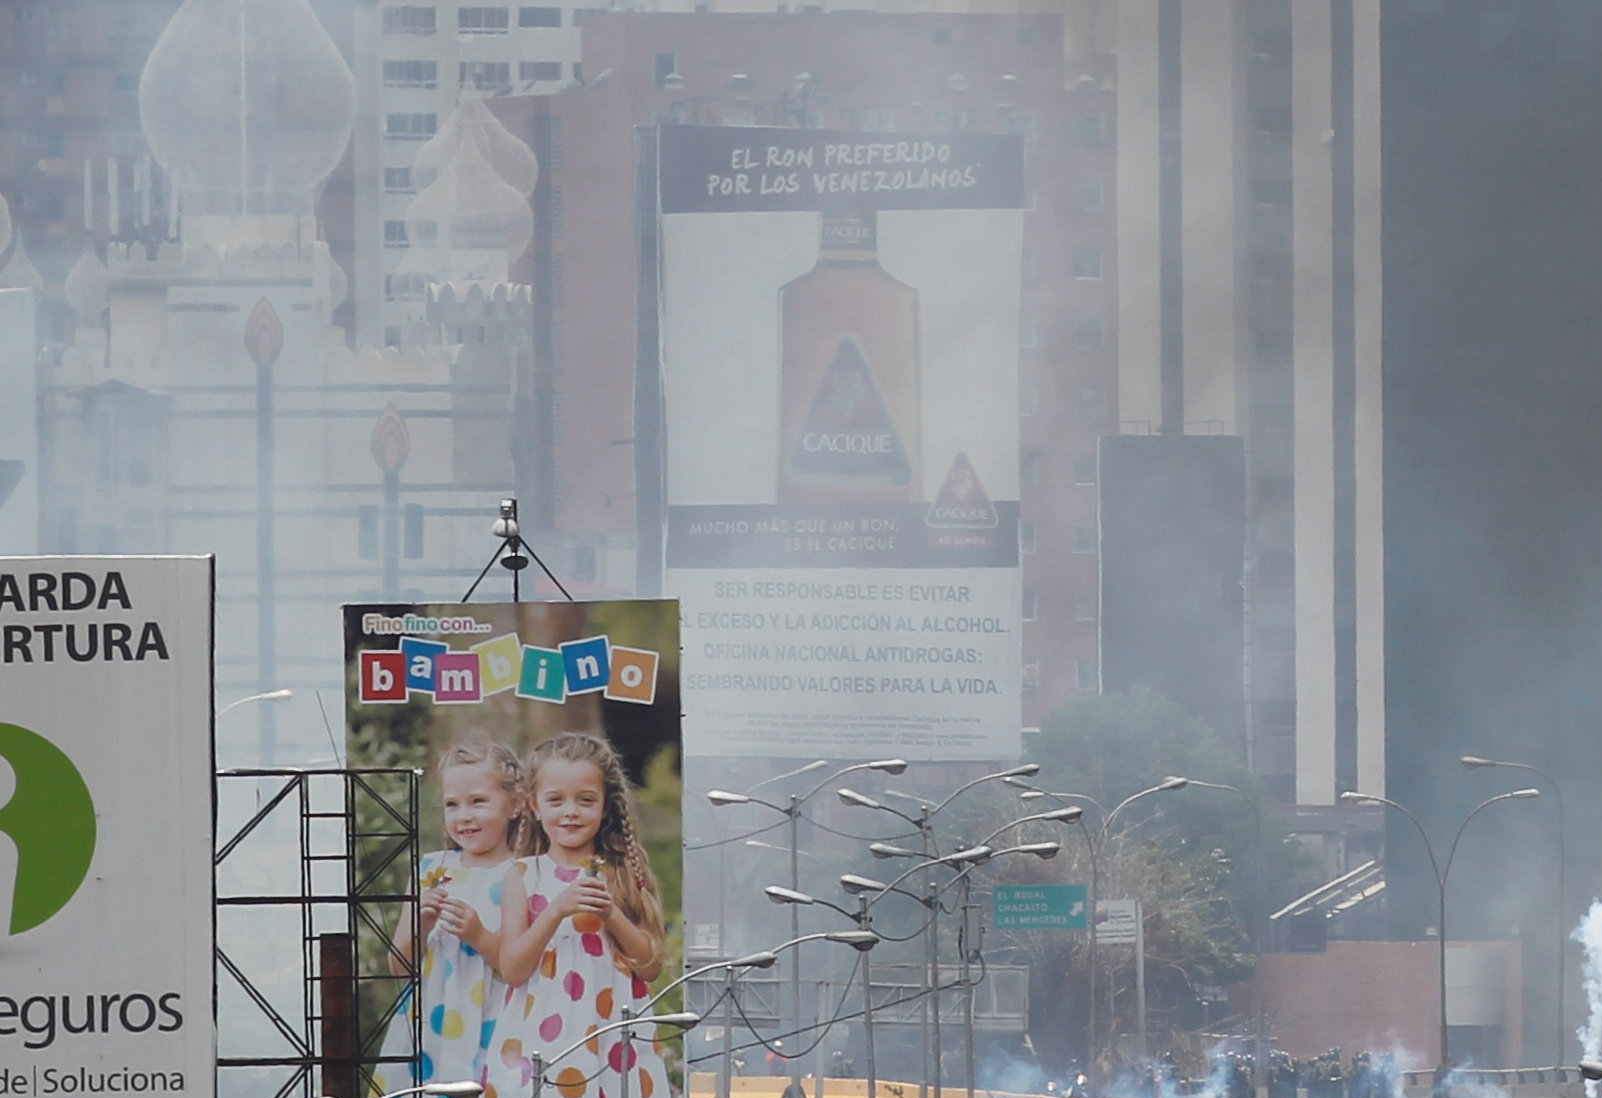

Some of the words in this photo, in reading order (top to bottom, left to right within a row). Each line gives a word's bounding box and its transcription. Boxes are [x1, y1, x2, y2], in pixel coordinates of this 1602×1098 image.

[731, 149, 760, 168] EL
[767, 146, 814, 168] RON
[825, 142, 950, 165] PREFERIDO
[707, 175, 752, 196] POR
[761, 173, 801, 194] LOS
[813, 166, 977, 193] VENEZOLANOS
[804, 433, 892, 453] CACIQUE
[689, 521, 749, 534] MUCHO
[795, 520, 825, 533] QUE
[833, 520, 853, 532] UN
[828, 536, 896, 550] CACIQUE
[0, 572, 132, 611] ARDA
[715, 582, 748, 599] SER
[753, 582, 877, 600] RESPONSABLE
[882, 584, 904, 599] ES
[909, 584, 969, 601] EVITAR
[698, 612, 766, 630] EXCESO
[769, 615, 780, 630] Y
[785, 614, 808, 631] LA
[811, 610, 891, 632] ADICCIÓN
[895, 615, 918, 632] AL
[921, 615, 1011, 634] ALCOHOL.
[3, 622, 170, 663] RTURA
[704, 643, 770, 662] OFICINA
[775, 644, 860, 662] NACIONAL
[864, 645, 983, 664] ANTIDROGAS:
[366, 641, 651, 697] bambino
[687, 674, 792, 691] SEMBRANDO
[798, 676, 876, 693] VALORES
[880, 679, 925, 694] PARA
[930, 679, 952, 694] LA
[958, 679, 1003, 695] VIDA.
[43, 1067, 184, 1093] Soluciona
